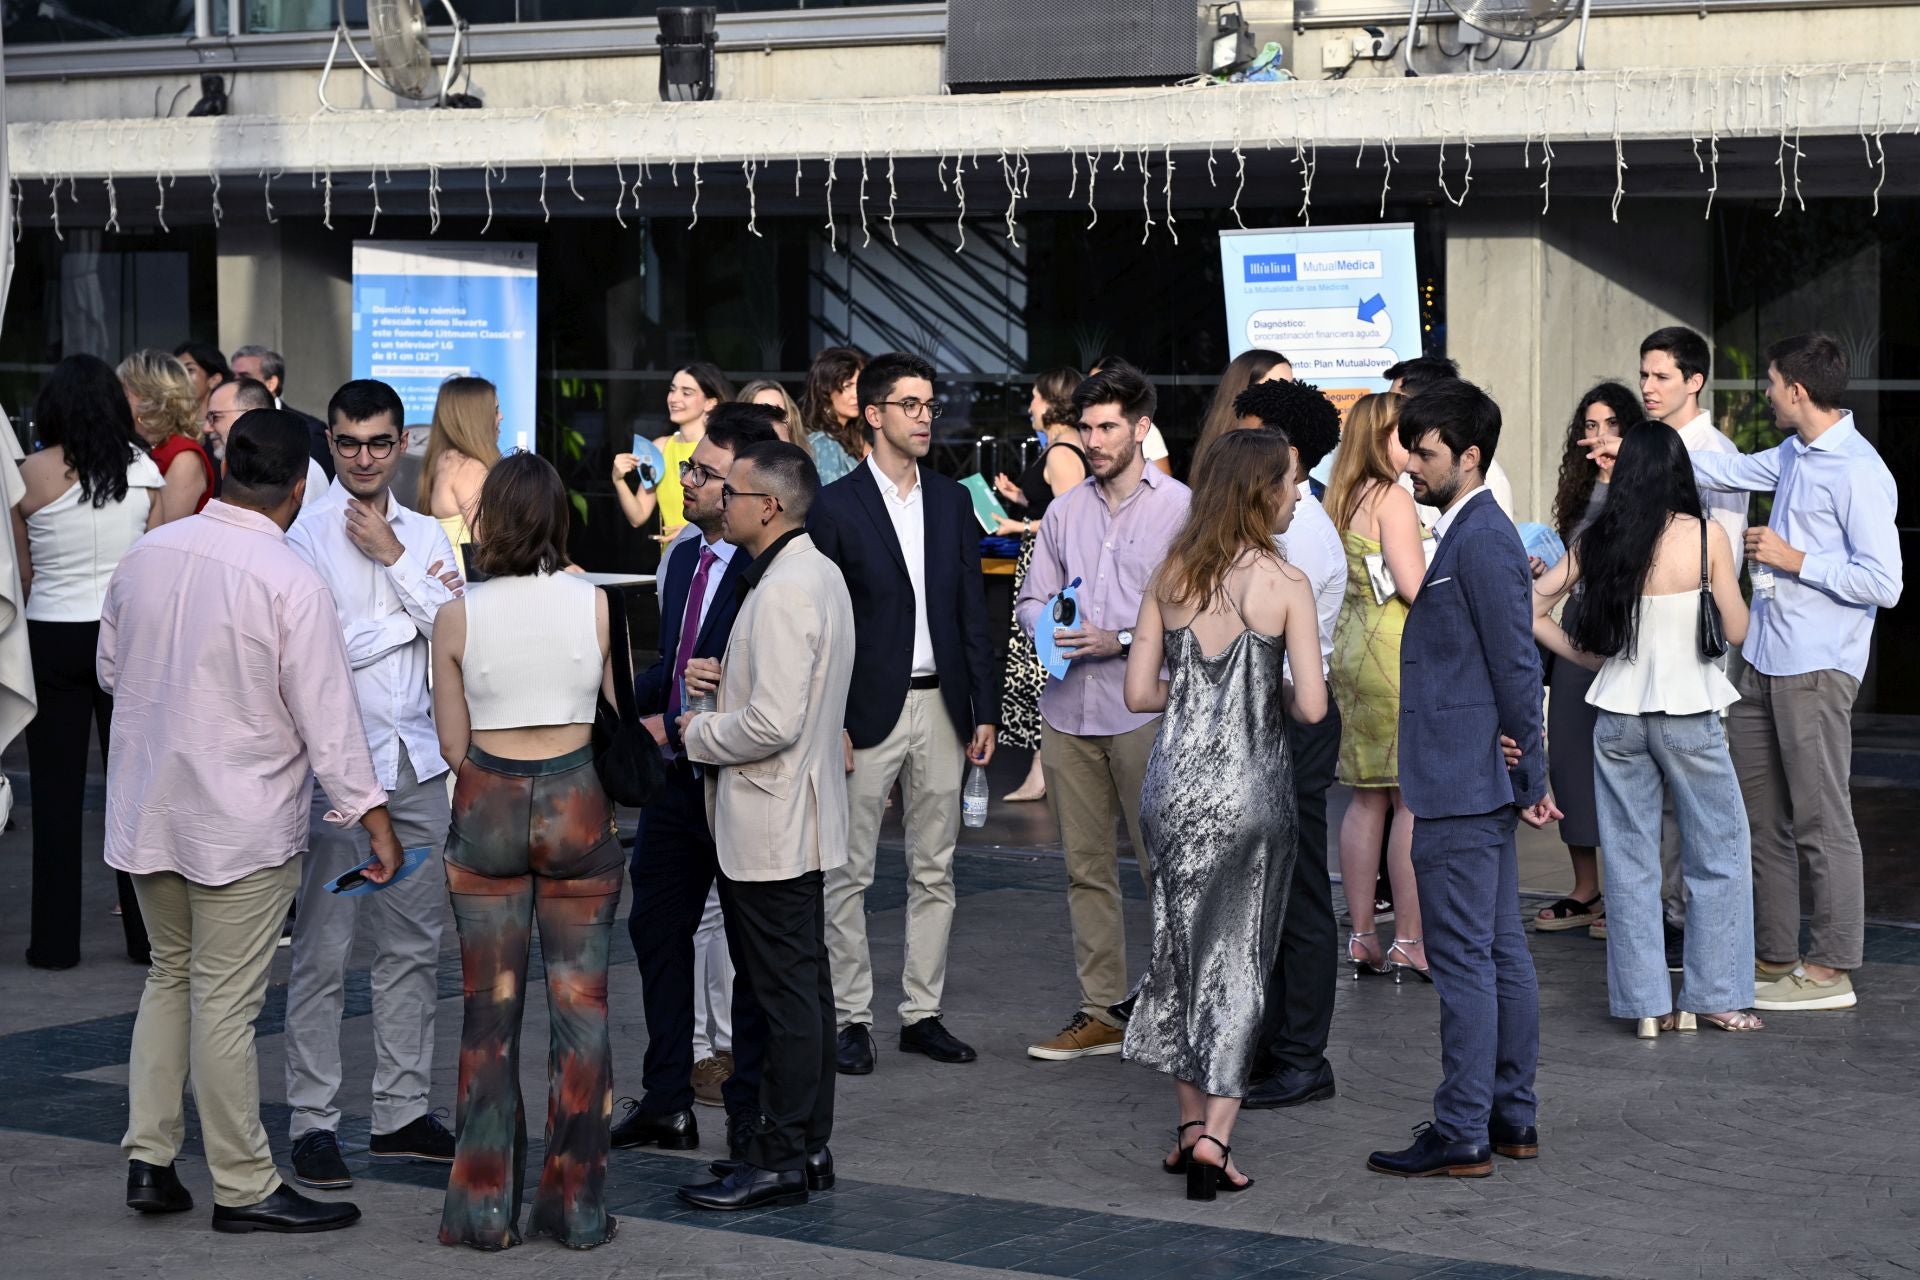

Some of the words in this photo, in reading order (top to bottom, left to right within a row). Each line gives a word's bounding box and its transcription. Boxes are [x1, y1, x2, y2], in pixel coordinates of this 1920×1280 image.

[418, 306, 429, 315] tu
[372, 318, 379, 328] y
[380, 317, 422, 327] descubre
[452, 317, 488, 328] llevarte
[372, 329, 392, 338] este
[394, 328, 433, 338] fonendo
[435, 329, 478, 339] Littmann
[380, 341, 394, 349] un
[441, 341, 454, 350] LG
[372, 351, 385, 361] de
[399, 353, 414, 361] cm
[1314, 359, 1333, 369] Plan
[1336, 357, 1392, 368] MutualJoven
